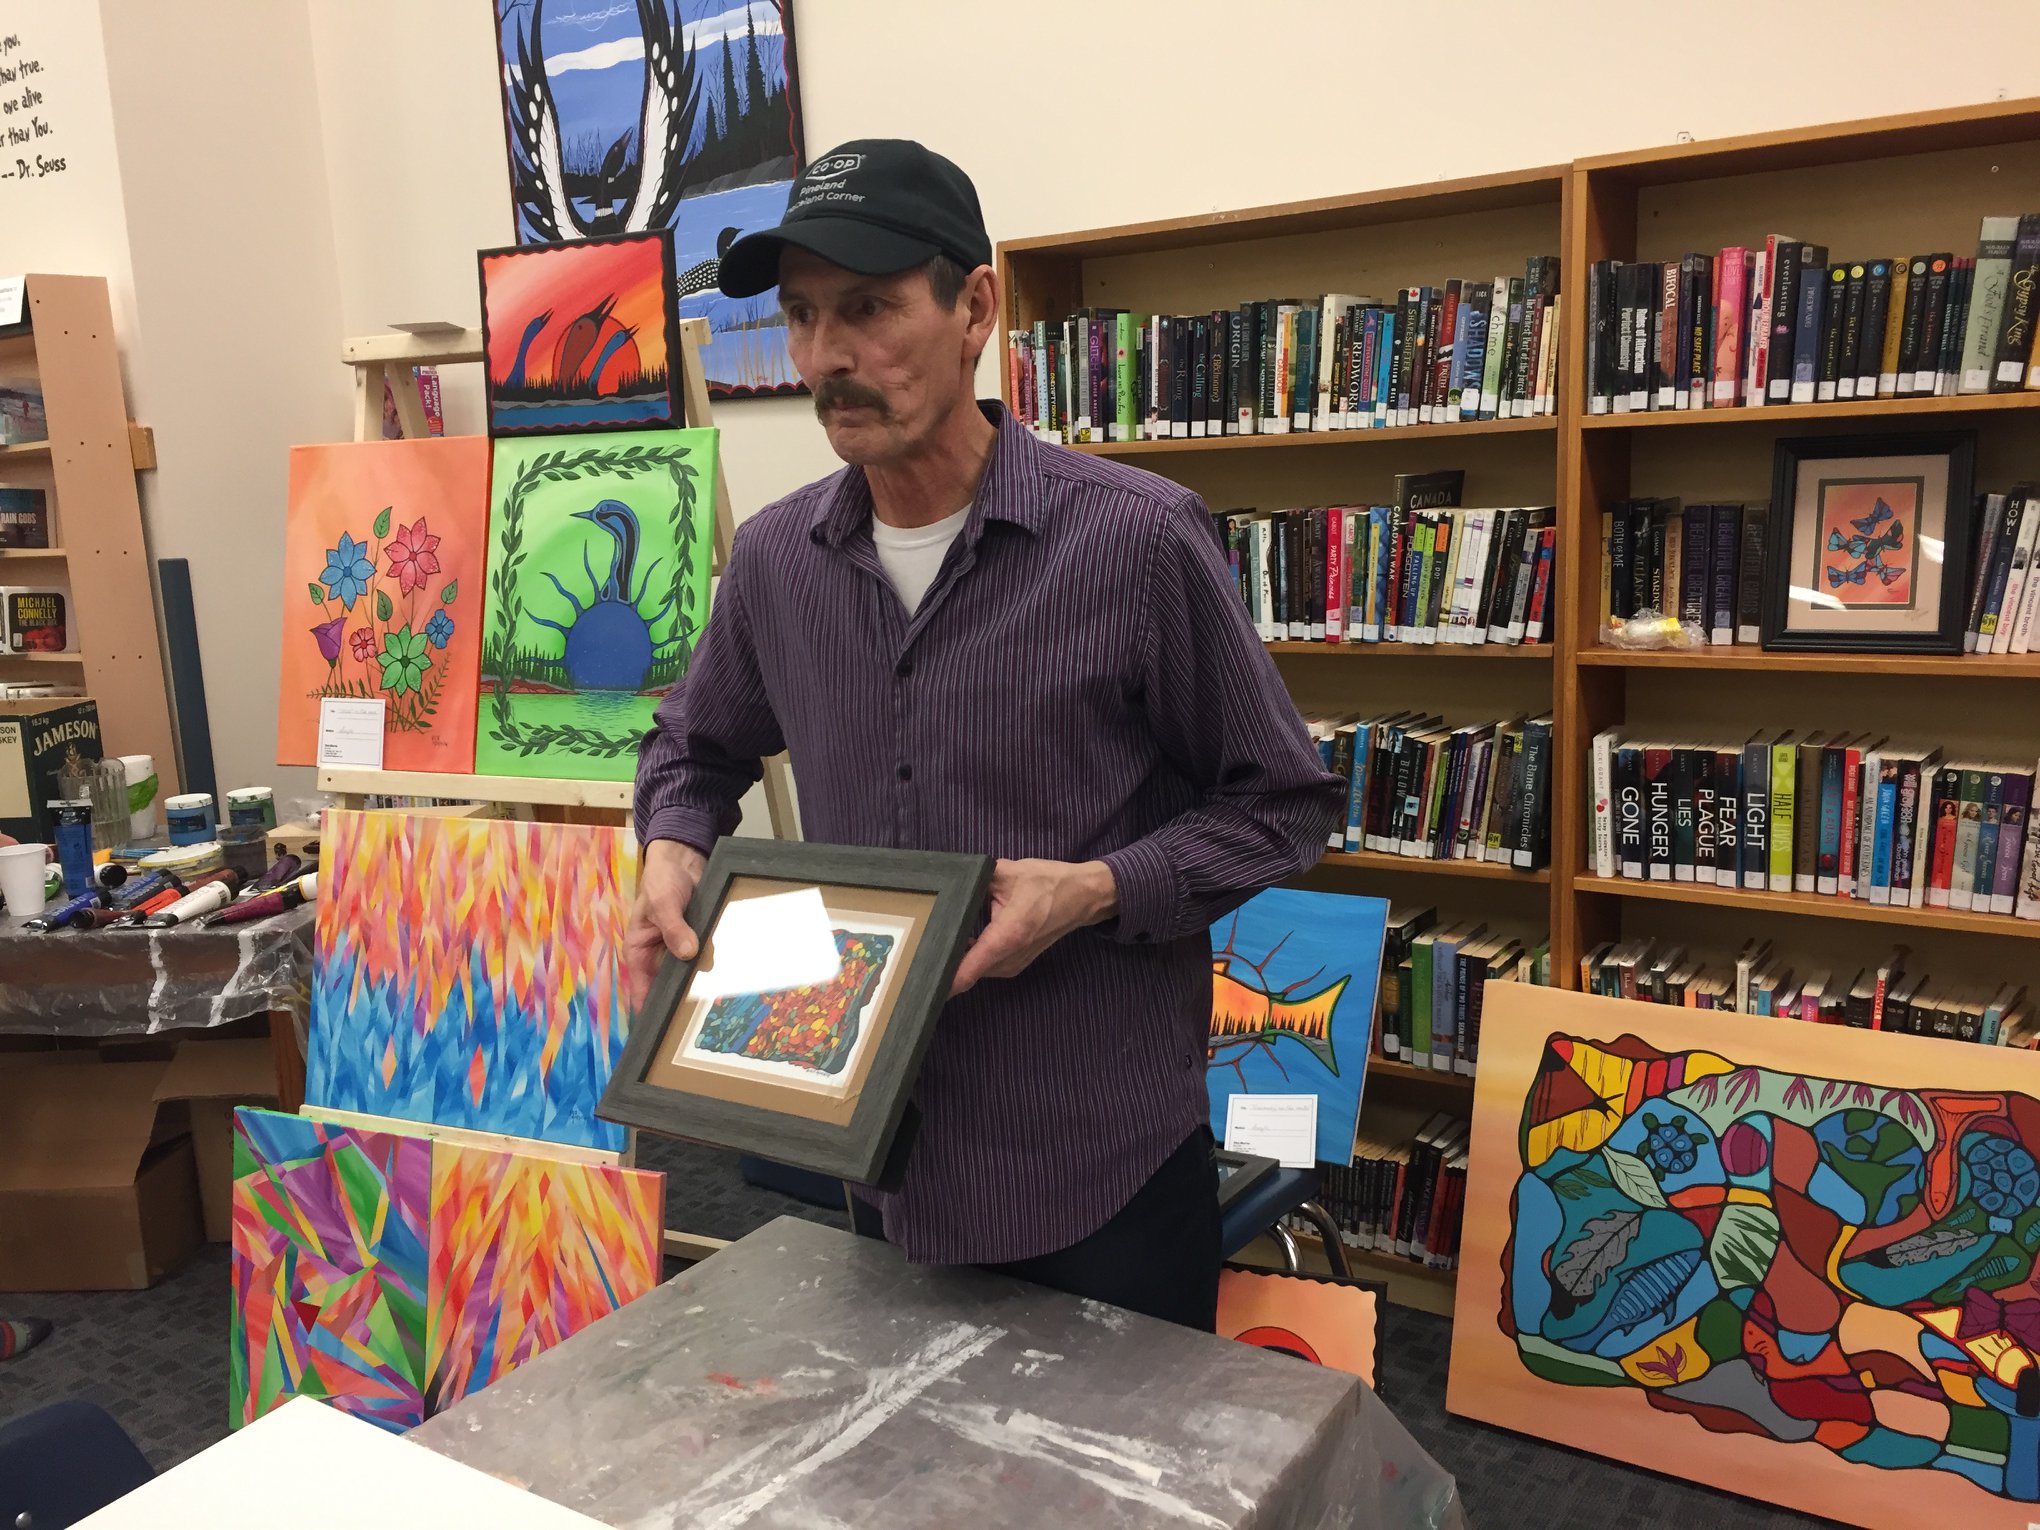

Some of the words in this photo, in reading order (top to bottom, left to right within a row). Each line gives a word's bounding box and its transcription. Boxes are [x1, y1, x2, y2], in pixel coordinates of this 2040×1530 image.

[19, 59, 44, 79] true.
[22, 87, 42, 109] alive
[31, 116, 53, 138] You.
[16, 159, 34, 179] Dr.
[36, 155, 66, 177] Seuss
[800, 179, 847, 196] Pineland
[826, 191, 865, 202] Corner
[1665, 268, 1678, 309] BIFOCAL
[1777, 259, 1791, 318] everlasting
[2013, 270, 2037, 316] Gypsy
[1621, 307, 1632, 334] Perfect
[1636, 308, 1648, 328] Rules
[1636, 329, 1647, 337] of
[1694, 326, 1702, 336] NO
[1759, 297, 1771, 350] TROUBLEMAKER
[2007, 317, 2029, 346] King
[1231, 316, 1241, 368] ORIGIN
[1401, 309, 1417, 375] SHAPESHIFTER
[1487, 315, 1503, 356] chime
[1693, 337, 1701, 353] SAFE
[1392, 355, 1400, 384] WILLIAM
[1463, 319, 1487, 389] SHADOWS
[1618, 335, 1631, 371] Chemistry
[1634, 338, 1646, 374] Attraction
[1692, 353, 1701, 373] PLACE
[1174, 370, 1187, 401] Rising
[1192, 363, 1206, 398] Calling
[1348, 341, 1363, 411] REDWORK
[424, 385, 432, 408] Pack!
[432, 375, 440, 417] Language
[1410, 490, 1452, 510] CANADA
[1391, 505, 1401, 545] CANADA
[1613, 521, 1624, 544] BOTH
[2005, 499, 2020, 536] HOWL
[1613, 553, 1623, 567] ME
[1688, 523, 1705, 572] BEAUTIFUL
[1716, 522, 1735, 572] BEAUTIFUL
[1743, 524, 1765, 578] BEAUTIFUL
[1402, 535, 1414, 599] FORGOTTEN
[1411, 555, 1420, 586] FALLING
[17, 597, 57, 608] MICHAEL
[1410, 587, 1417, 597] UP
[1652, 568, 1660, 611] STARDUS
[1742, 580, 1758, 614] CHAOS
[17, 608, 57, 619] CONNELLY
[33, 720, 96, 757] JAMESON
[1528, 745, 1538, 762] The
[1396, 759, 1411, 799] BELOW
[1525, 764, 1538, 791] Bane
[1520, 792, 1535, 848] Chronicles
[1621, 786, 1640, 845] GONE
[1651, 782, 1668, 857] HUNGER
[1677, 798, 1692, 827] LIES
[1719, 796, 1736, 847] FEAR
[1746, 792, 1766, 851] LIGHT
[1773, 792, 1792, 819] HALF
[1698, 788, 1715, 858] PLAGUE
